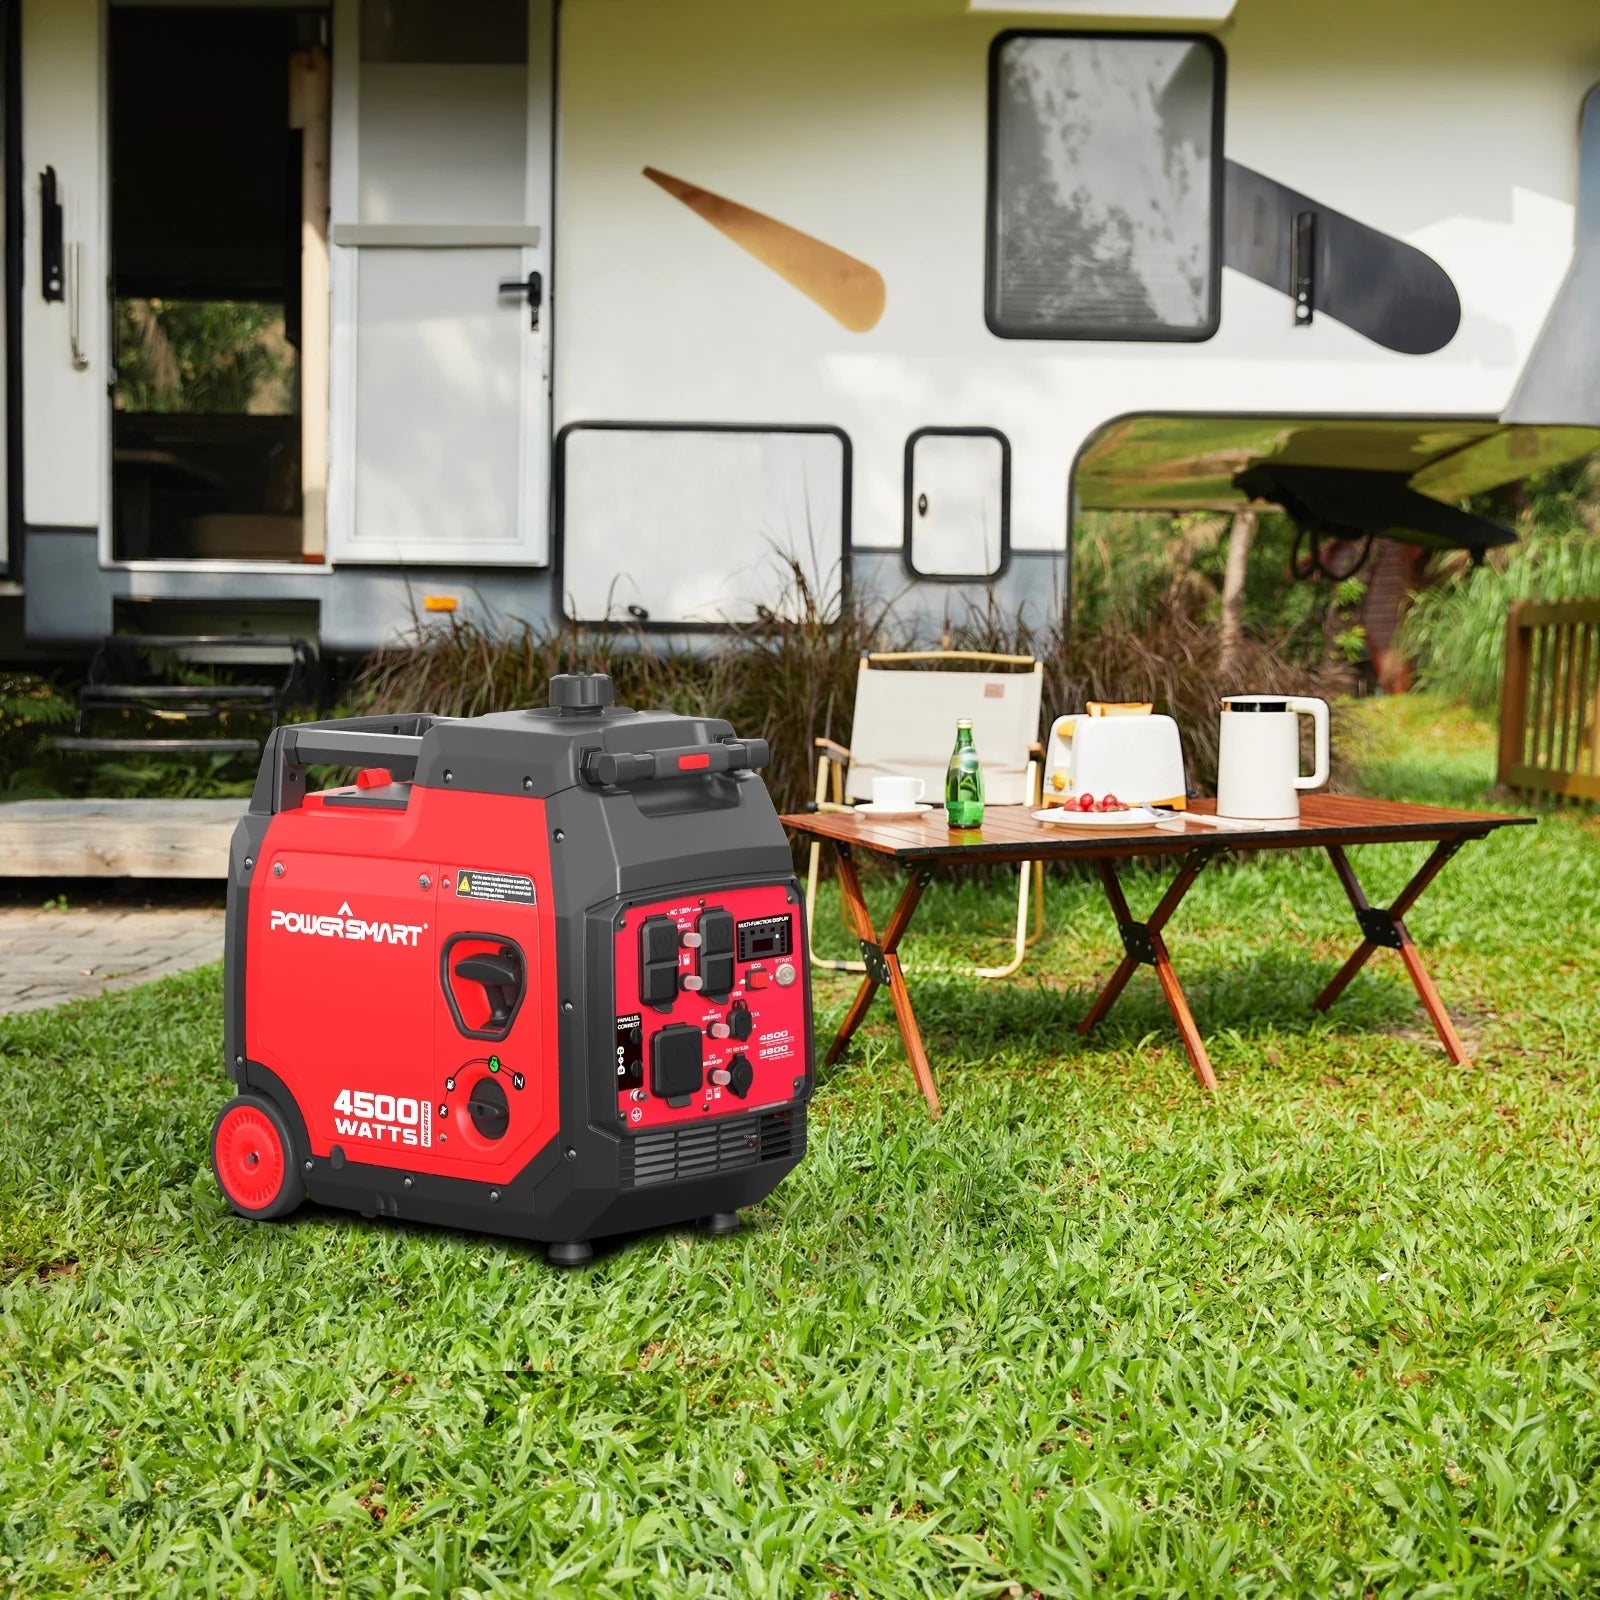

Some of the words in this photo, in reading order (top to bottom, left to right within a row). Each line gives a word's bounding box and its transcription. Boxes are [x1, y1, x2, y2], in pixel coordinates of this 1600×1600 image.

[772, 916, 789, 924] DISPLAY
[617, 1015, 640, 1024] PARALLEL
[702, 1013, 721, 1021] BREAKER
[617, 1021, 640, 1030] CONNECT
[759, 1030, 788, 1041] 4500
[759, 1045, 788, 1056] 3800
[333, 1089, 419, 1126] 4500
[334, 1117, 418, 1146] WATTS
